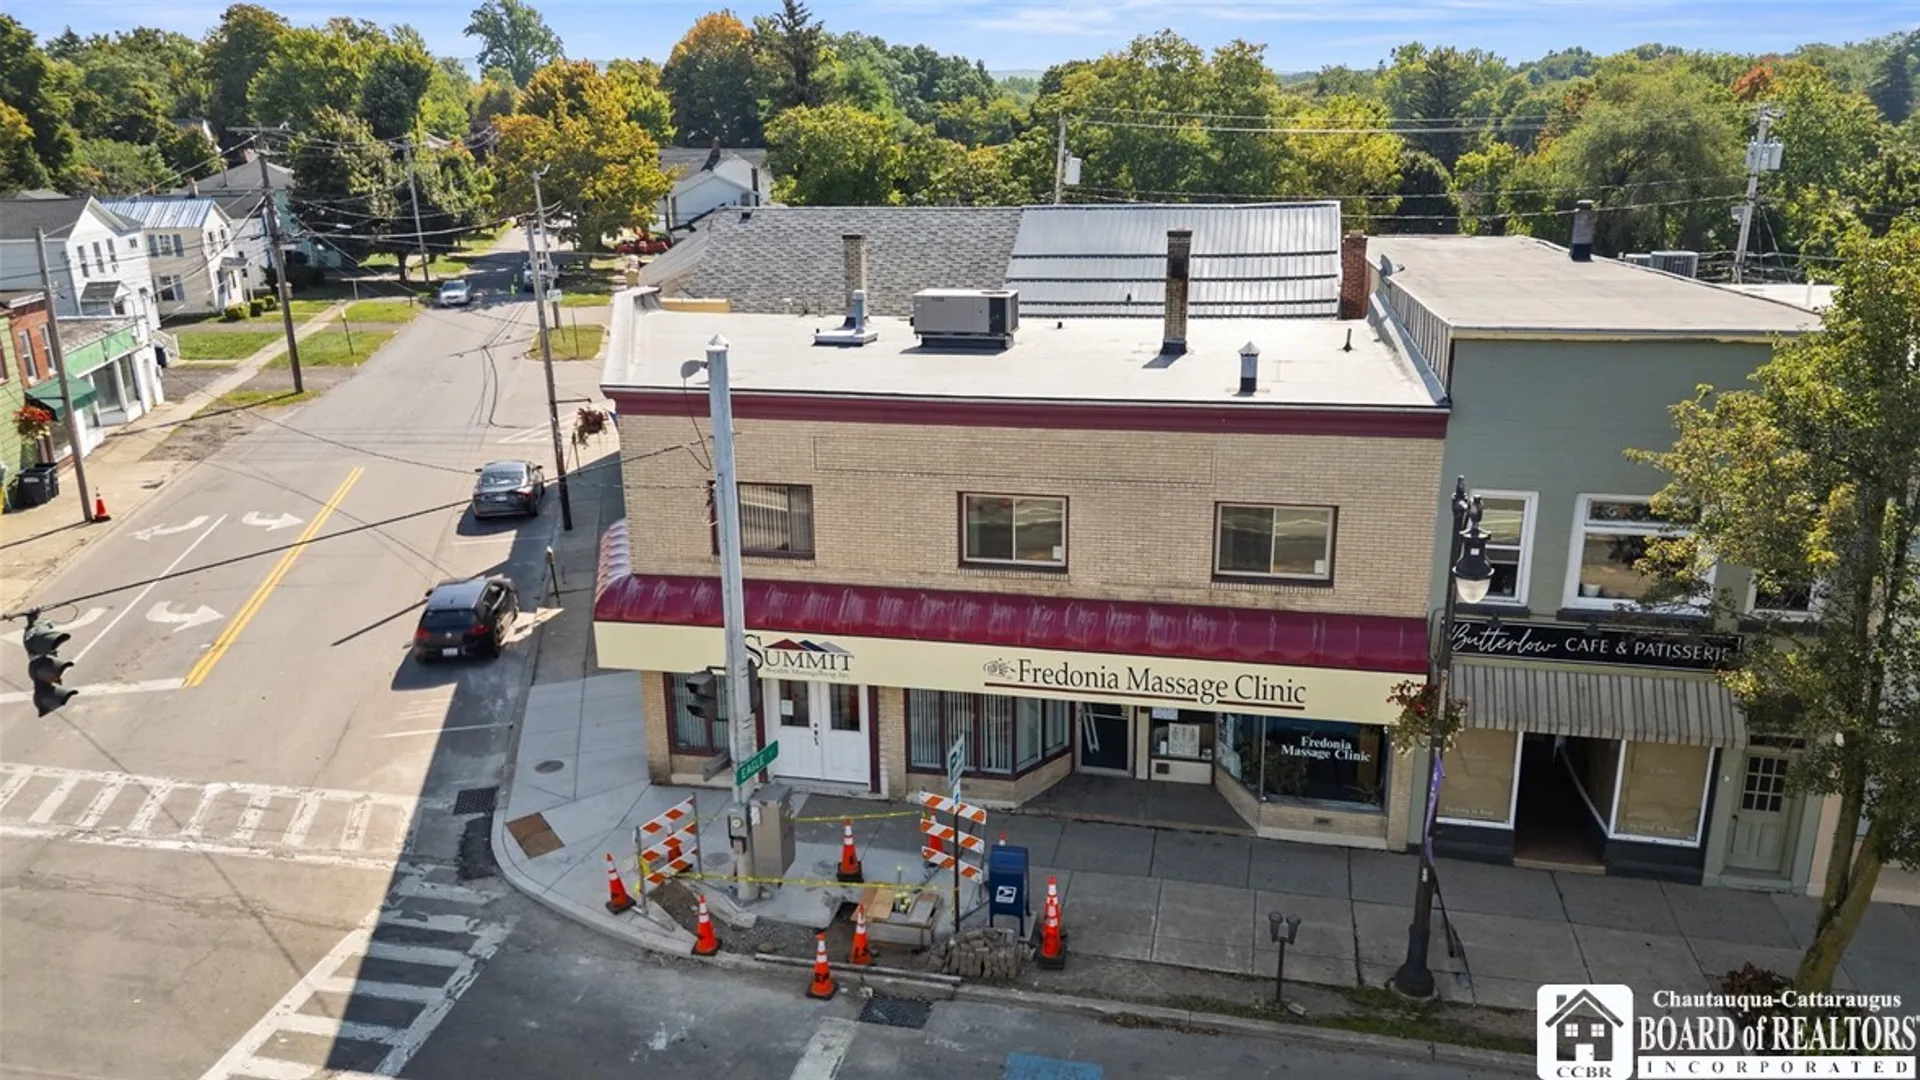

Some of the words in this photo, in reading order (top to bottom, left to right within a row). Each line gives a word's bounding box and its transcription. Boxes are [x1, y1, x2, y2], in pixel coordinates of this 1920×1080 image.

[745, 634, 855, 671] SUMMIT
[1451, 623, 1557, 653] Butterlow
[1565, 637, 1609, 654] CAFE
[1615, 641, 1628, 655] &
[1018, 659, 1119, 690] Fredonia
[1126, 666, 1229, 705] Massage
[1235, 674, 1307, 704] Clinic
[1281, 744, 1331, 760] Massage
[1334, 748, 1371, 762] Clinic
[1301, 736, 1352, 750] Fredonia
[741, 753, 764, 780] EAGLE
